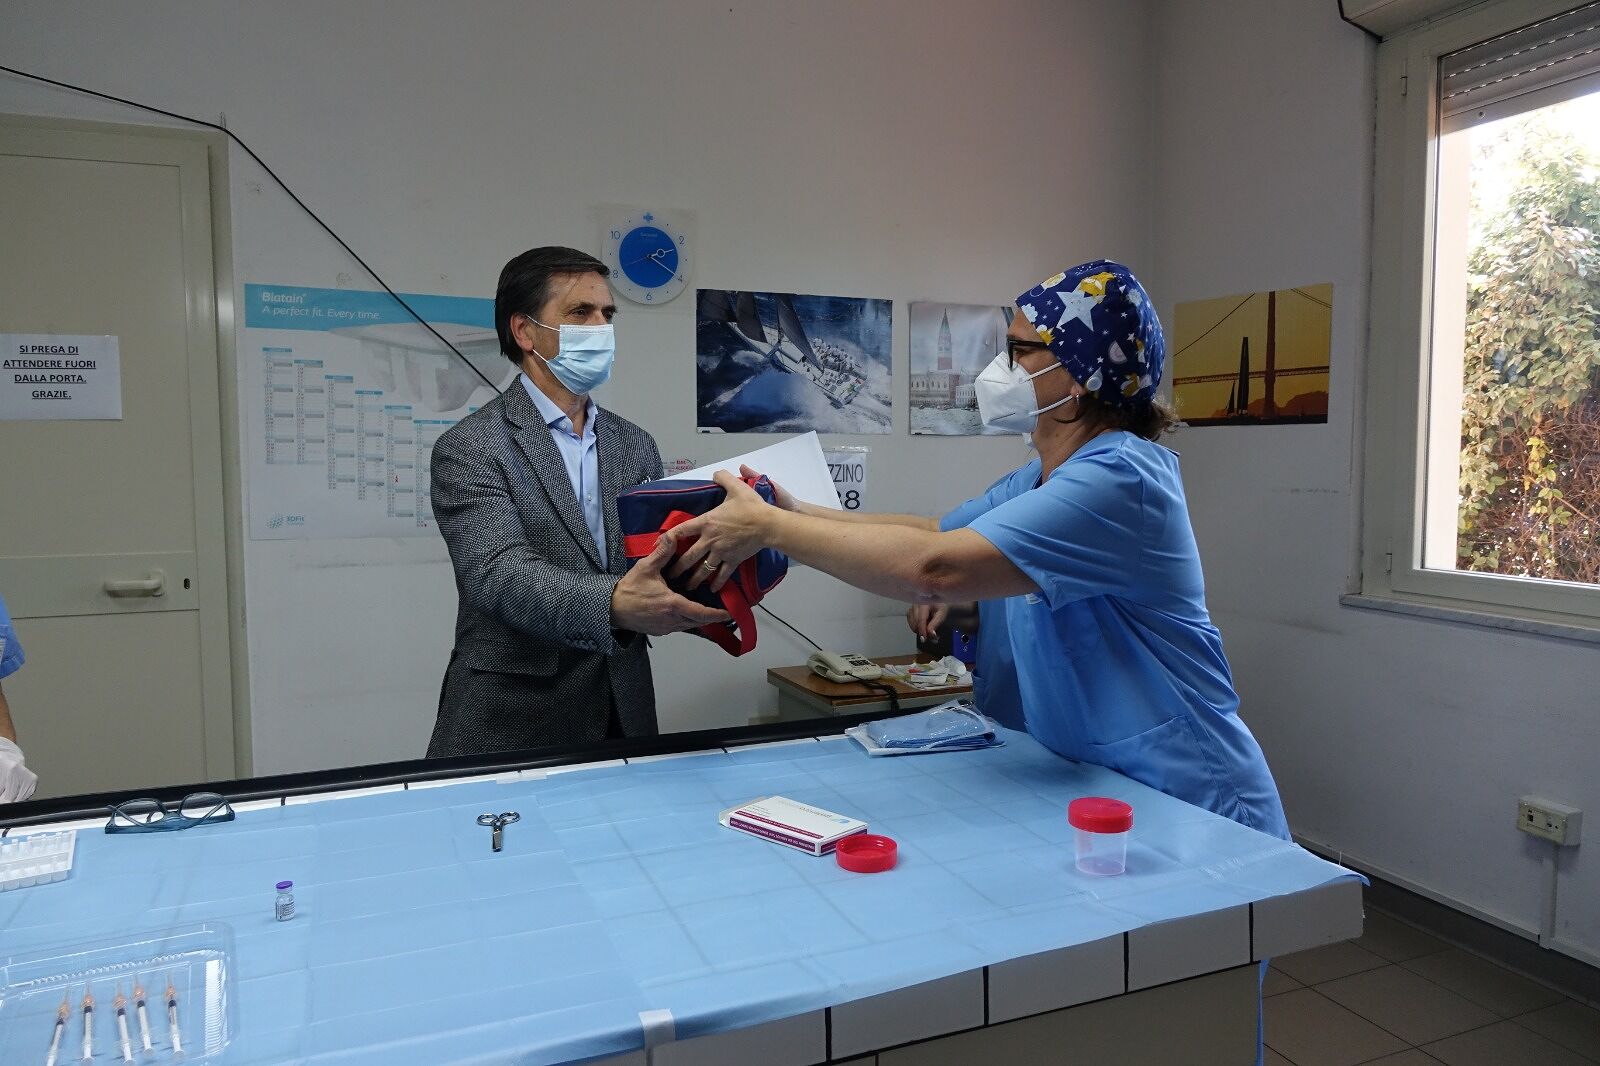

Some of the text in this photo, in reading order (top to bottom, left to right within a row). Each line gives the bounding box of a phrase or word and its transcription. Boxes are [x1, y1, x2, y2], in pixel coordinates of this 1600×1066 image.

[610, 230, 621, 240] 10
[678, 235, 685, 245] 2
[612, 269, 619, 279] 8
[645, 291, 652, 301] 6
[262, 305, 270, 314] A
[273, 307, 309, 317] perfect
[327, 309, 356, 319] Every
[19, 345, 79, 355] SI PREGA DI
[3, 359, 96, 369] ATTENDERE FUORI
[14, 374, 87, 384] DALLA PORTA.
[32, 390, 72, 399] GRAZIE.
[837, 490, 861, 510] 8
